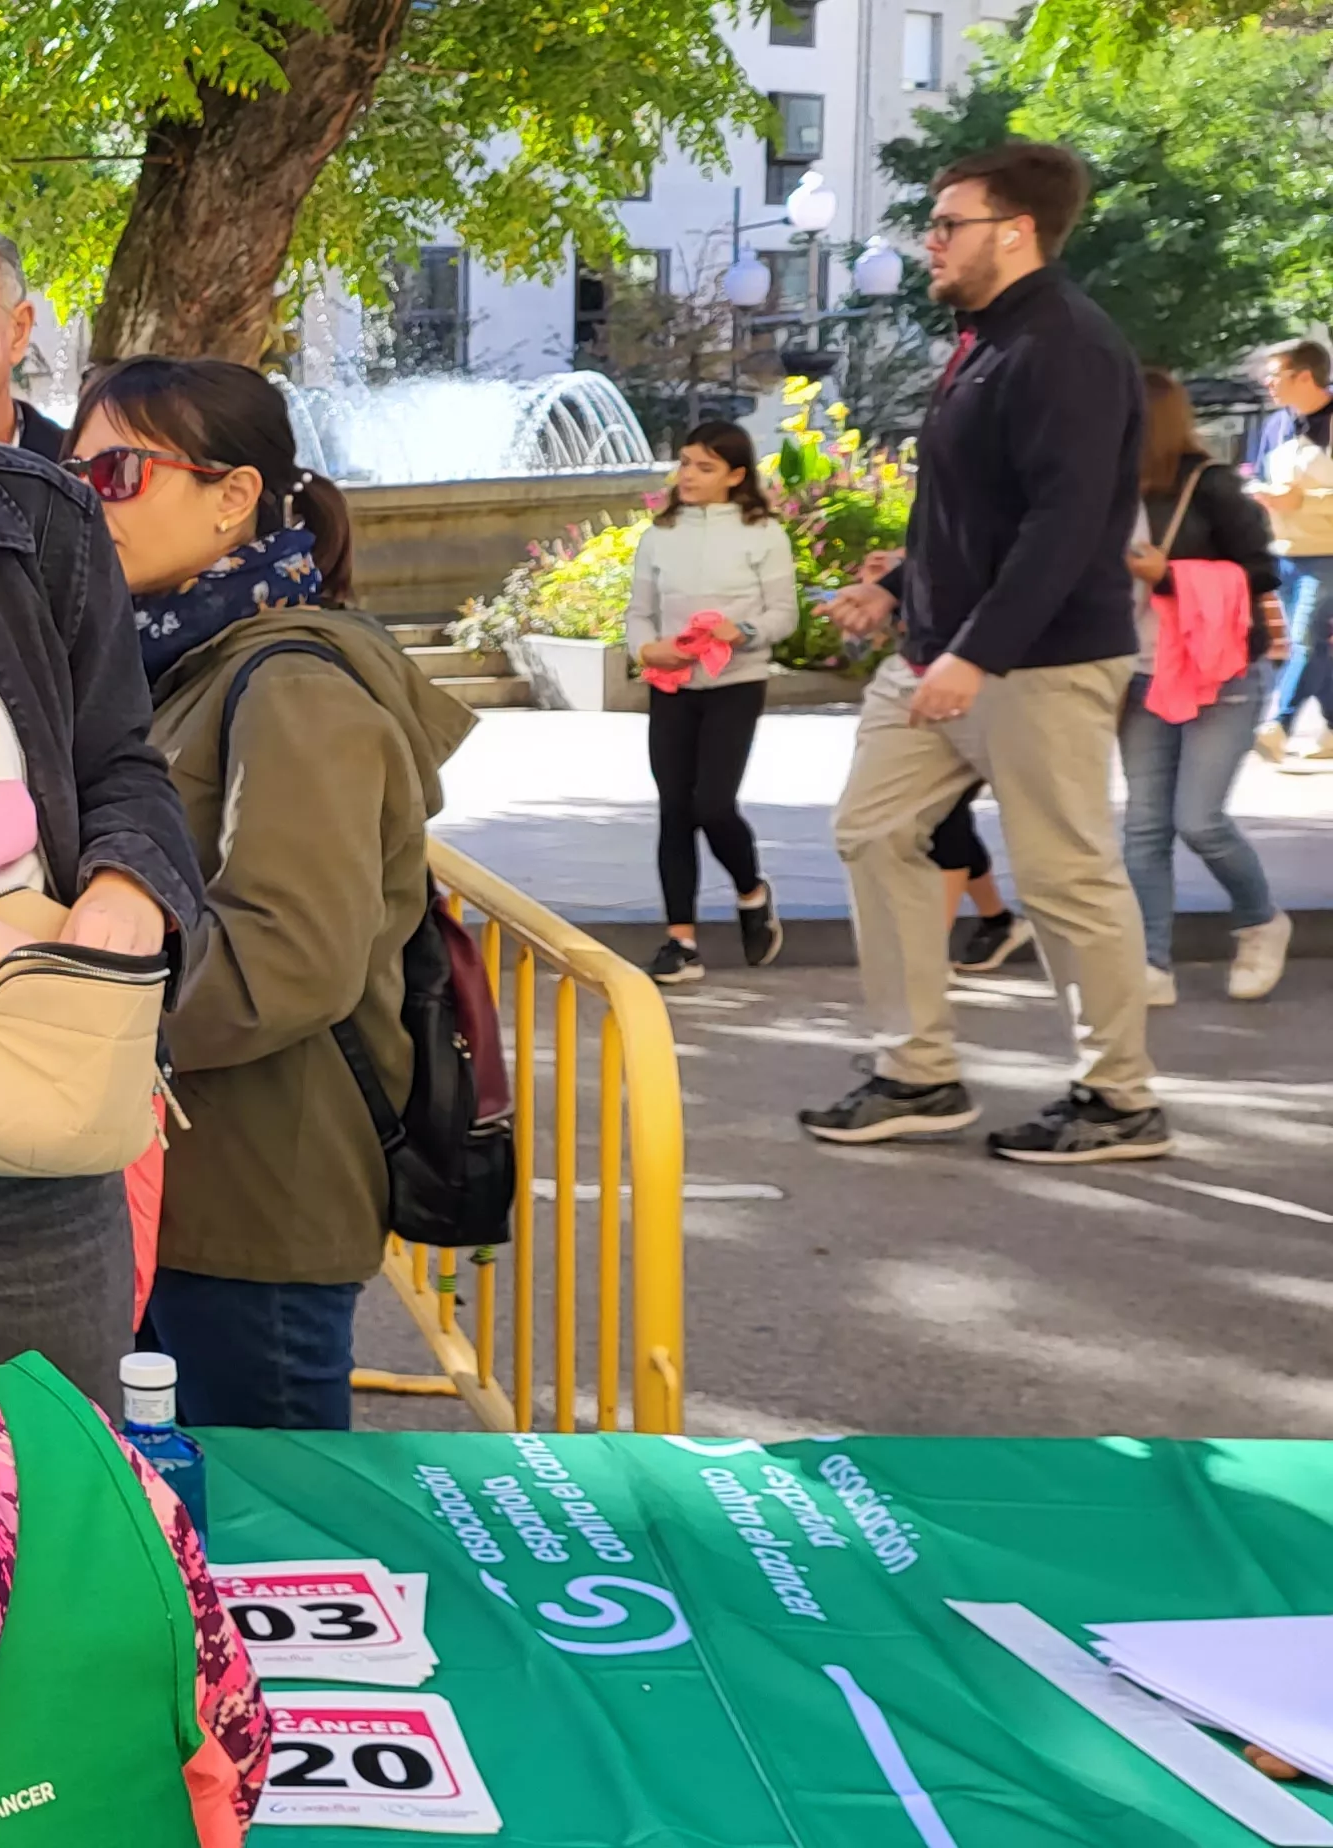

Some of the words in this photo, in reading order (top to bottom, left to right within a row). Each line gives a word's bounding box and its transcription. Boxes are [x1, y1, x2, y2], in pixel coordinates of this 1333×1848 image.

[412, 1464, 506, 1563] asociación
[479, 1475, 569, 1563] española
[533, 1481, 585, 1499] el
[699, 1467, 765, 1526] contra
[818, 1454, 921, 1575] asociación
[561, 1501, 634, 1563] contra
[736, 1526, 793, 1548] el
[750, 1547, 828, 1622] cáncer
